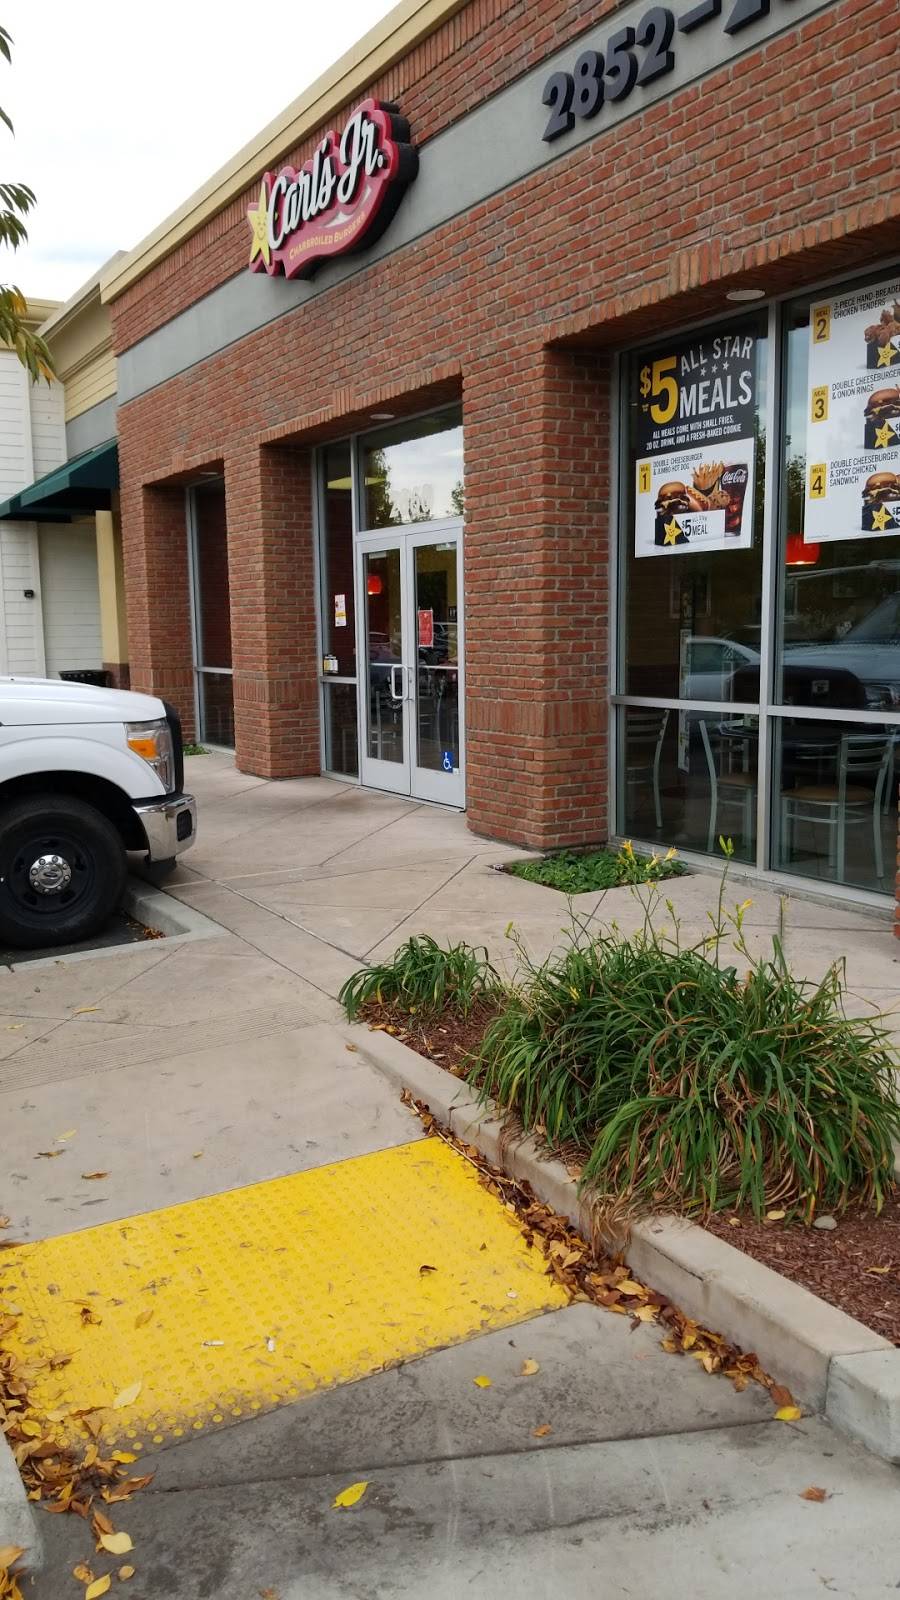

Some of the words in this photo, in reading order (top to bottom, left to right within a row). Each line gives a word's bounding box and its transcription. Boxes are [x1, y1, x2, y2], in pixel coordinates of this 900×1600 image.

[268, 137, 336, 250] Carl's
[337, 112, 384, 204] Jr.
[289, 234, 333, 260] CHARBROILED
[834, 307, 858, 320] CHICKEN
[816, 318, 827, 340] 2
[681, 345, 708, 377] ALL
[713, 335, 753, 360] STAR
[640, 355, 679, 425] $5
[680, 370, 752, 419] MEALS
[832, 379, 855, 392] DOUBLE
[837, 388, 855, 399] ONION
[857, 384, 874, 394] RINGS
[815, 398, 824, 419] 3
[653, 430, 661, 440] ALL
[676, 424, 689, 435] COME
[690, 421, 702, 432] WITH
[702, 418, 718, 430] SMALL
[676, 434, 686, 444] AND
[690, 426, 722, 441] FRESH-BAKED
[723, 423, 742, 435] COOKIE
[653, 458, 669, 468] DOUBLE
[670, 452, 703, 465] CHEESEBURGER
[680, 463, 690, 471] DOG
[830, 458, 852, 470] DOUBLE
[853, 451, 899, 467] CHEESEBURGER
[835, 468, 851, 477] SPICY
[851, 464, 877, 475] CHICKEN
[642, 472, 647, 491] 1
[812, 475, 823, 495] 4
[830, 476, 859, 488] SANDWICH
[682, 519, 692, 537] $5
[692, 524, 708, 536] MEAL
